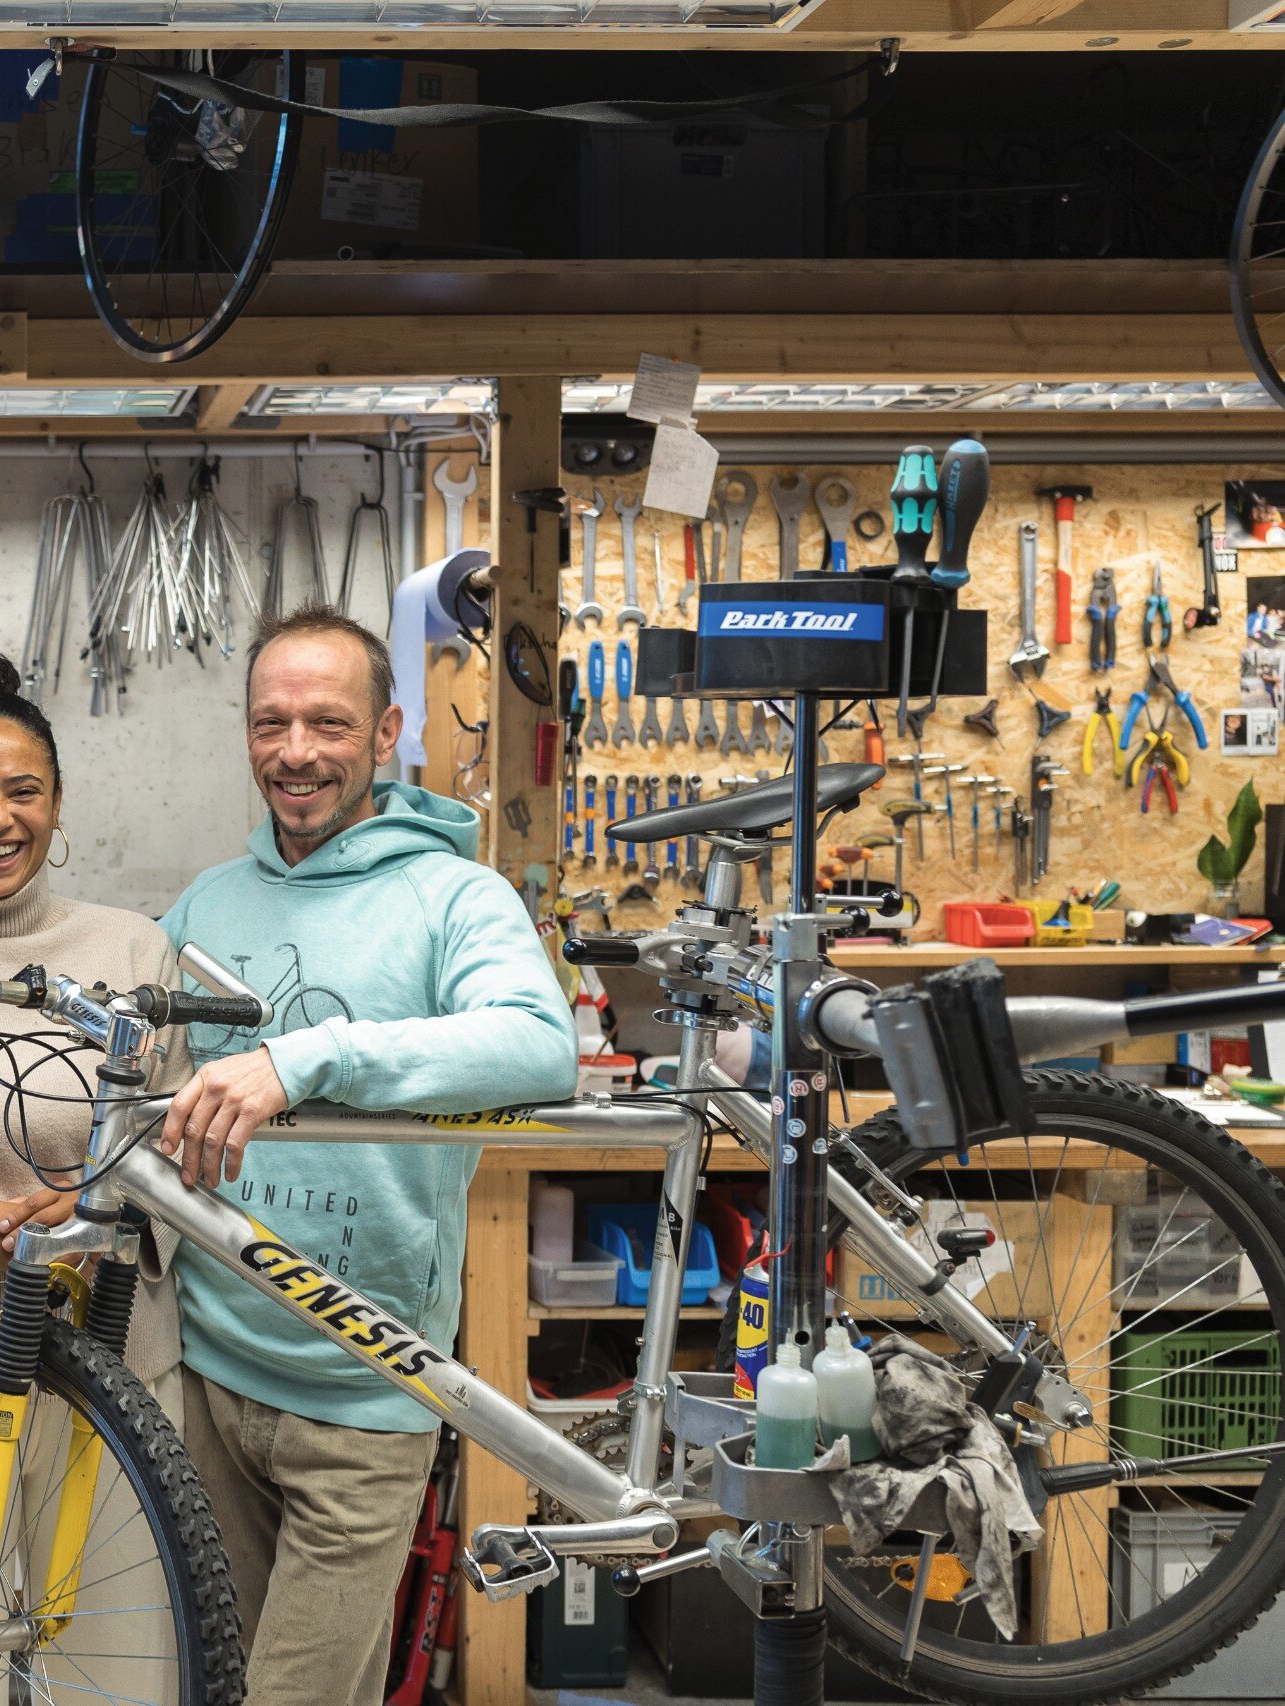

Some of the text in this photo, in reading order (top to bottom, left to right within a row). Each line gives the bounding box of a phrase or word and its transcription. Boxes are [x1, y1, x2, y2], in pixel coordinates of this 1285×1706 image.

[720, 611, 856, 632] Park Tool
[70, 1002, 108, 1027] GENESIS
[241, 1180, 358, 1217] UNITED
[240, 1241, 447, 1376] GENESIS
[740, 1301, 764, 1330] -40
